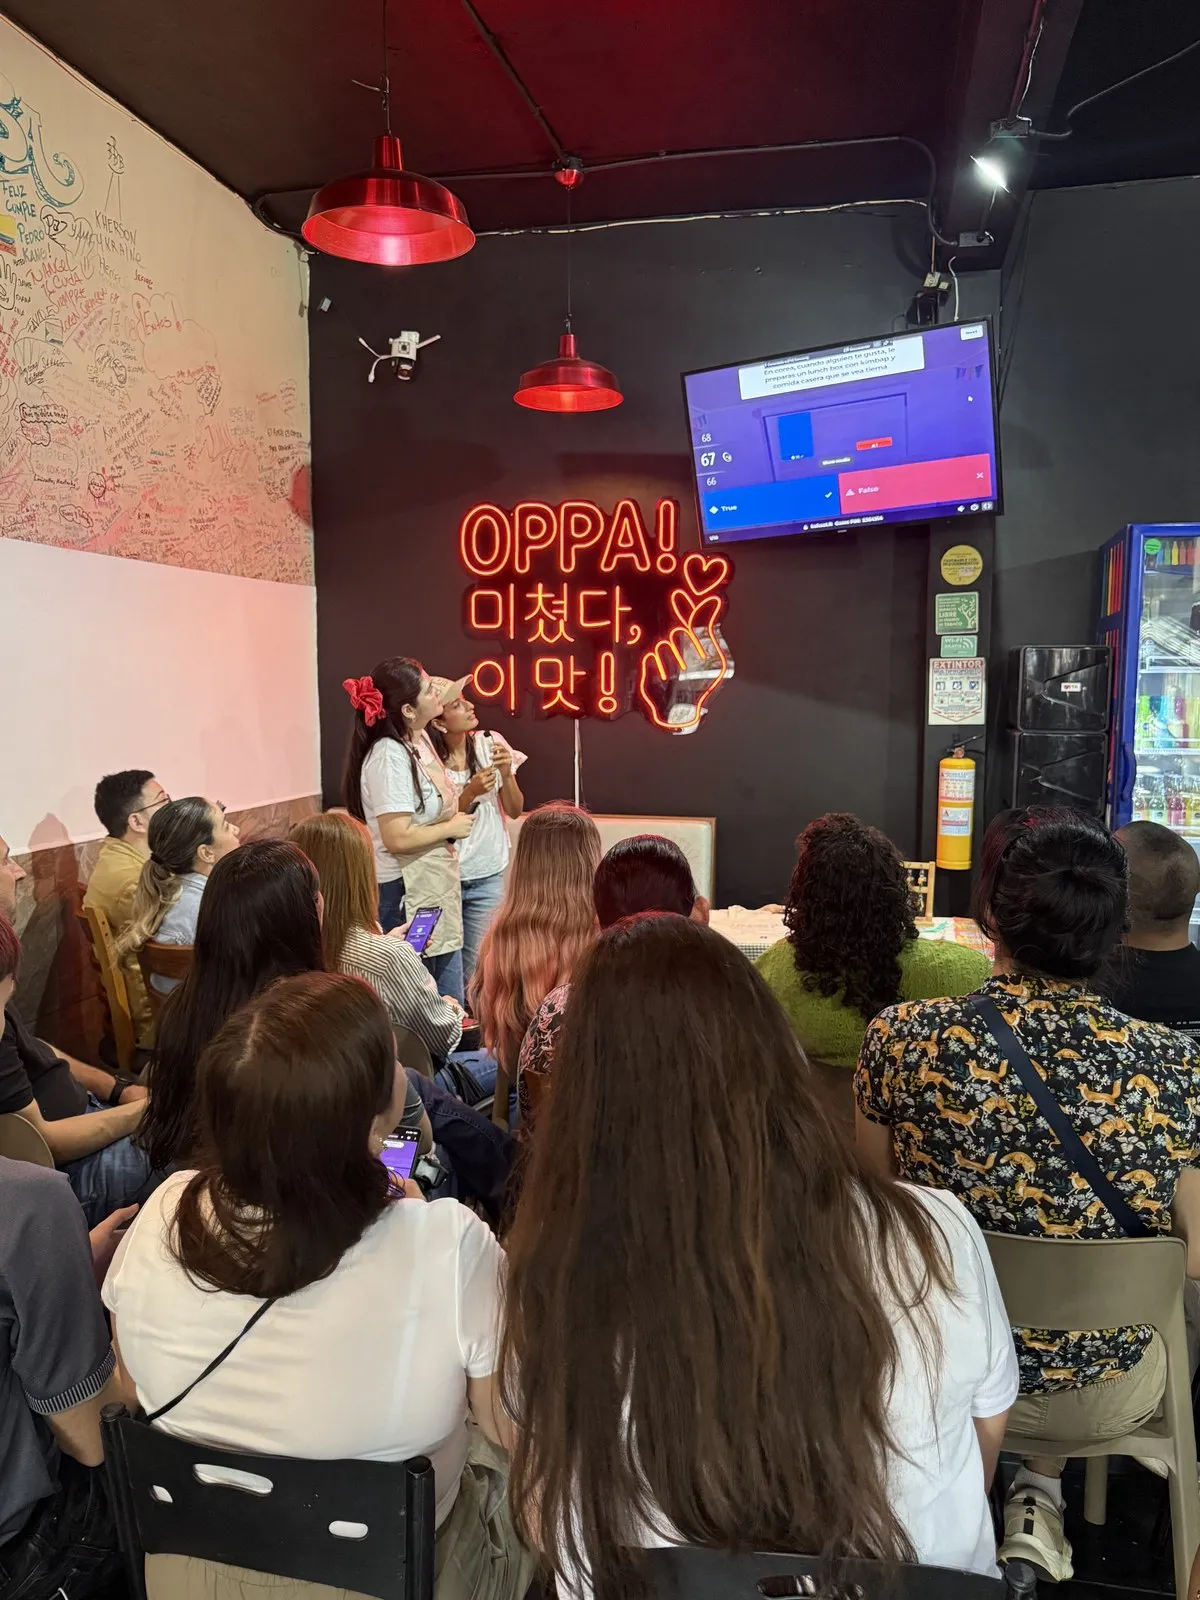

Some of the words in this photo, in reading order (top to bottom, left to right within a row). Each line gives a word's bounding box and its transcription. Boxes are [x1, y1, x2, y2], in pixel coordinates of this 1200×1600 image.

[16, 222, 45, 246] PEDRO
[94, 209, 137, 246] KHERSON
[796, 359, 825, 371] cuando
[825, 354, 854, 367] alguien
[863, 349, 888, 361] gusta,
[764, 373, 796, 385] preparas
[807, 366, 829, 376] lunch
[829, 364, 844, 372] box
[844, 361, 860, 370] con
[860, 355, 890, 368] kimbap
[772, 379, 800, 389] comida
[800, 375, 825, 385] casera
[825, 373, 841, 382] que
[701, 433, 712, 443] 68
[700, 451, 716, 467] 67
[706, 476, 717, 487] 66
[857, 485, 880, 495] False
[720, 504, 738, 512] True
[460, 499, 677, 576] OPPA!
[470, 582, 642, 645] 미쳤다,
[932, 660, 982, 669] EXTINTOR
[472, 654, 516, 711] 이
